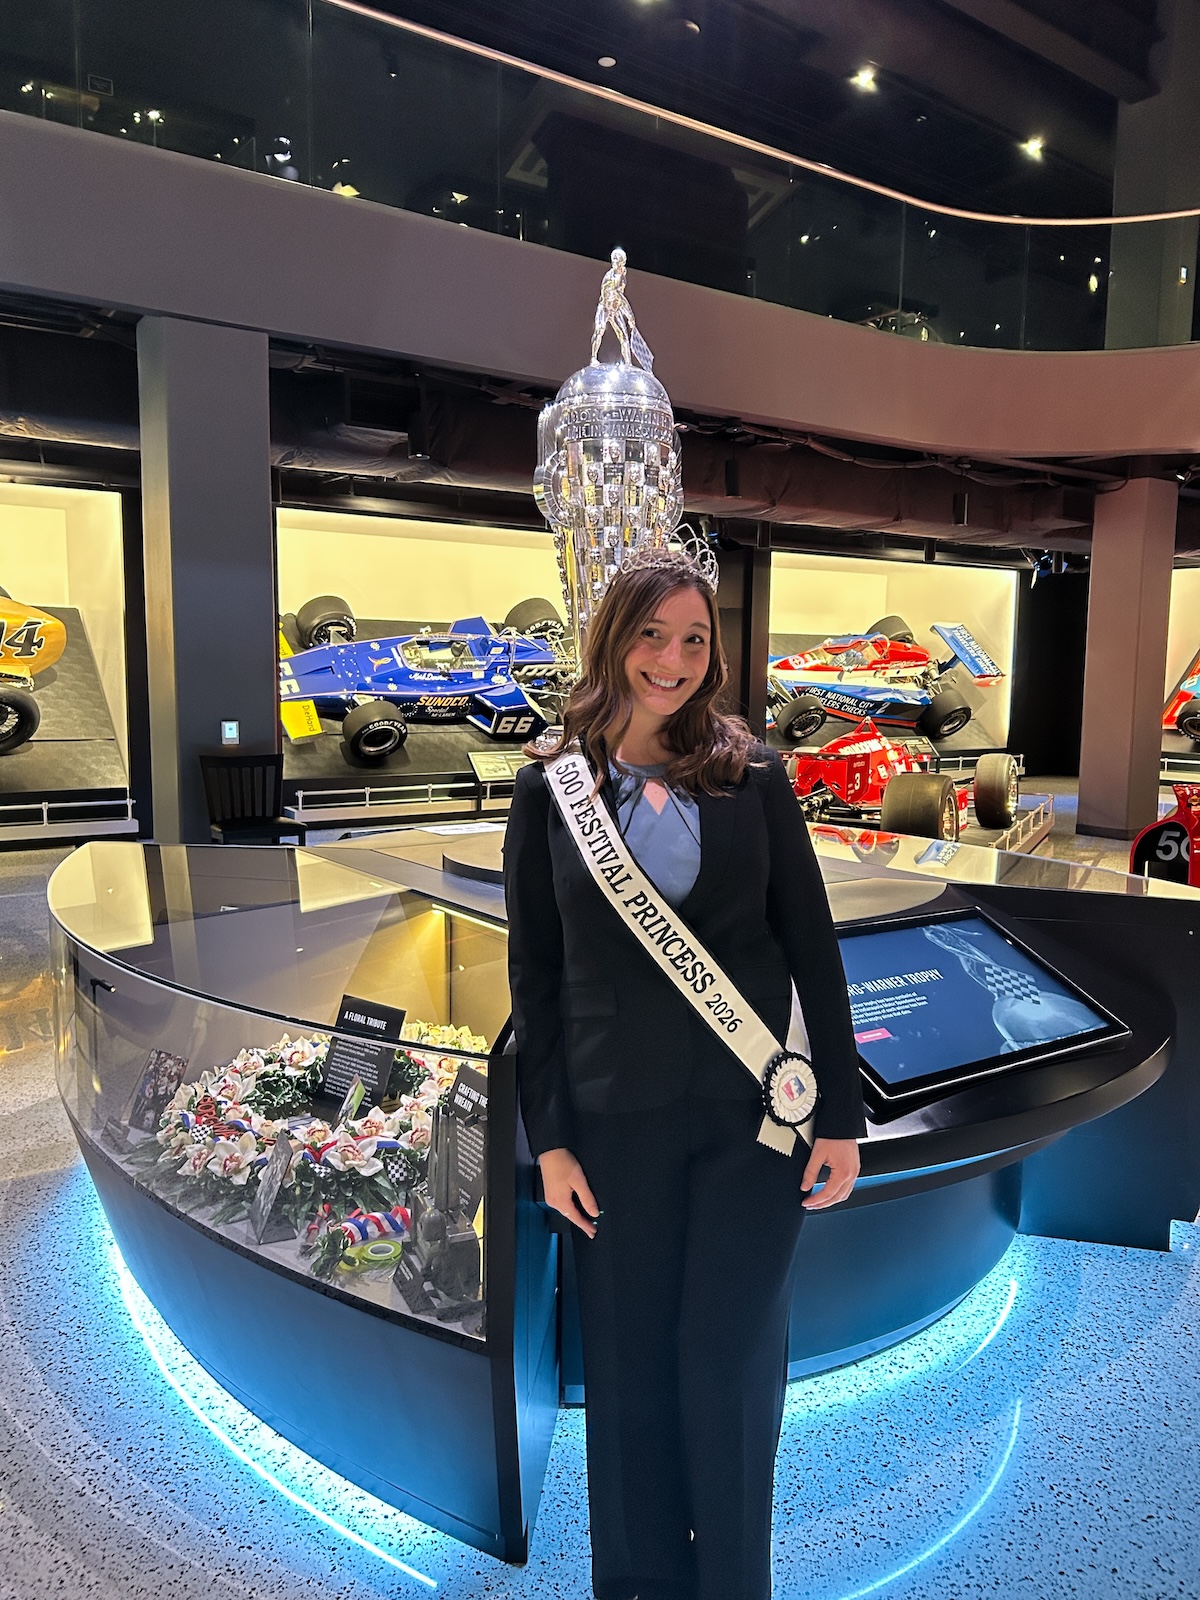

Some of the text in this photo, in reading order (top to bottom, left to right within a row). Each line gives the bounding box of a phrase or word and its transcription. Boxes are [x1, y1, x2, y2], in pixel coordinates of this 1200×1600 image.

[416, 695, 470, 706] SUNOCO
[826, 691, 858, 707] NATIONAL
[858, 700, 874, 710] CITY
[841, 703, 868, 716] CHECKS
[876, 701, 891, 715] 2
[496, 716, 535, 733] 66
[854, 772, 861, 791] 3
[555, 761, 743, 1033] 500 FESTIVAL PRINCESS 2026
[847, 968, 944, 997] RG-WARNER TROPHY
[348, 1011, 366, 1025] FLORAL
[366, 1016, 388, 1031] TRIBUTE
